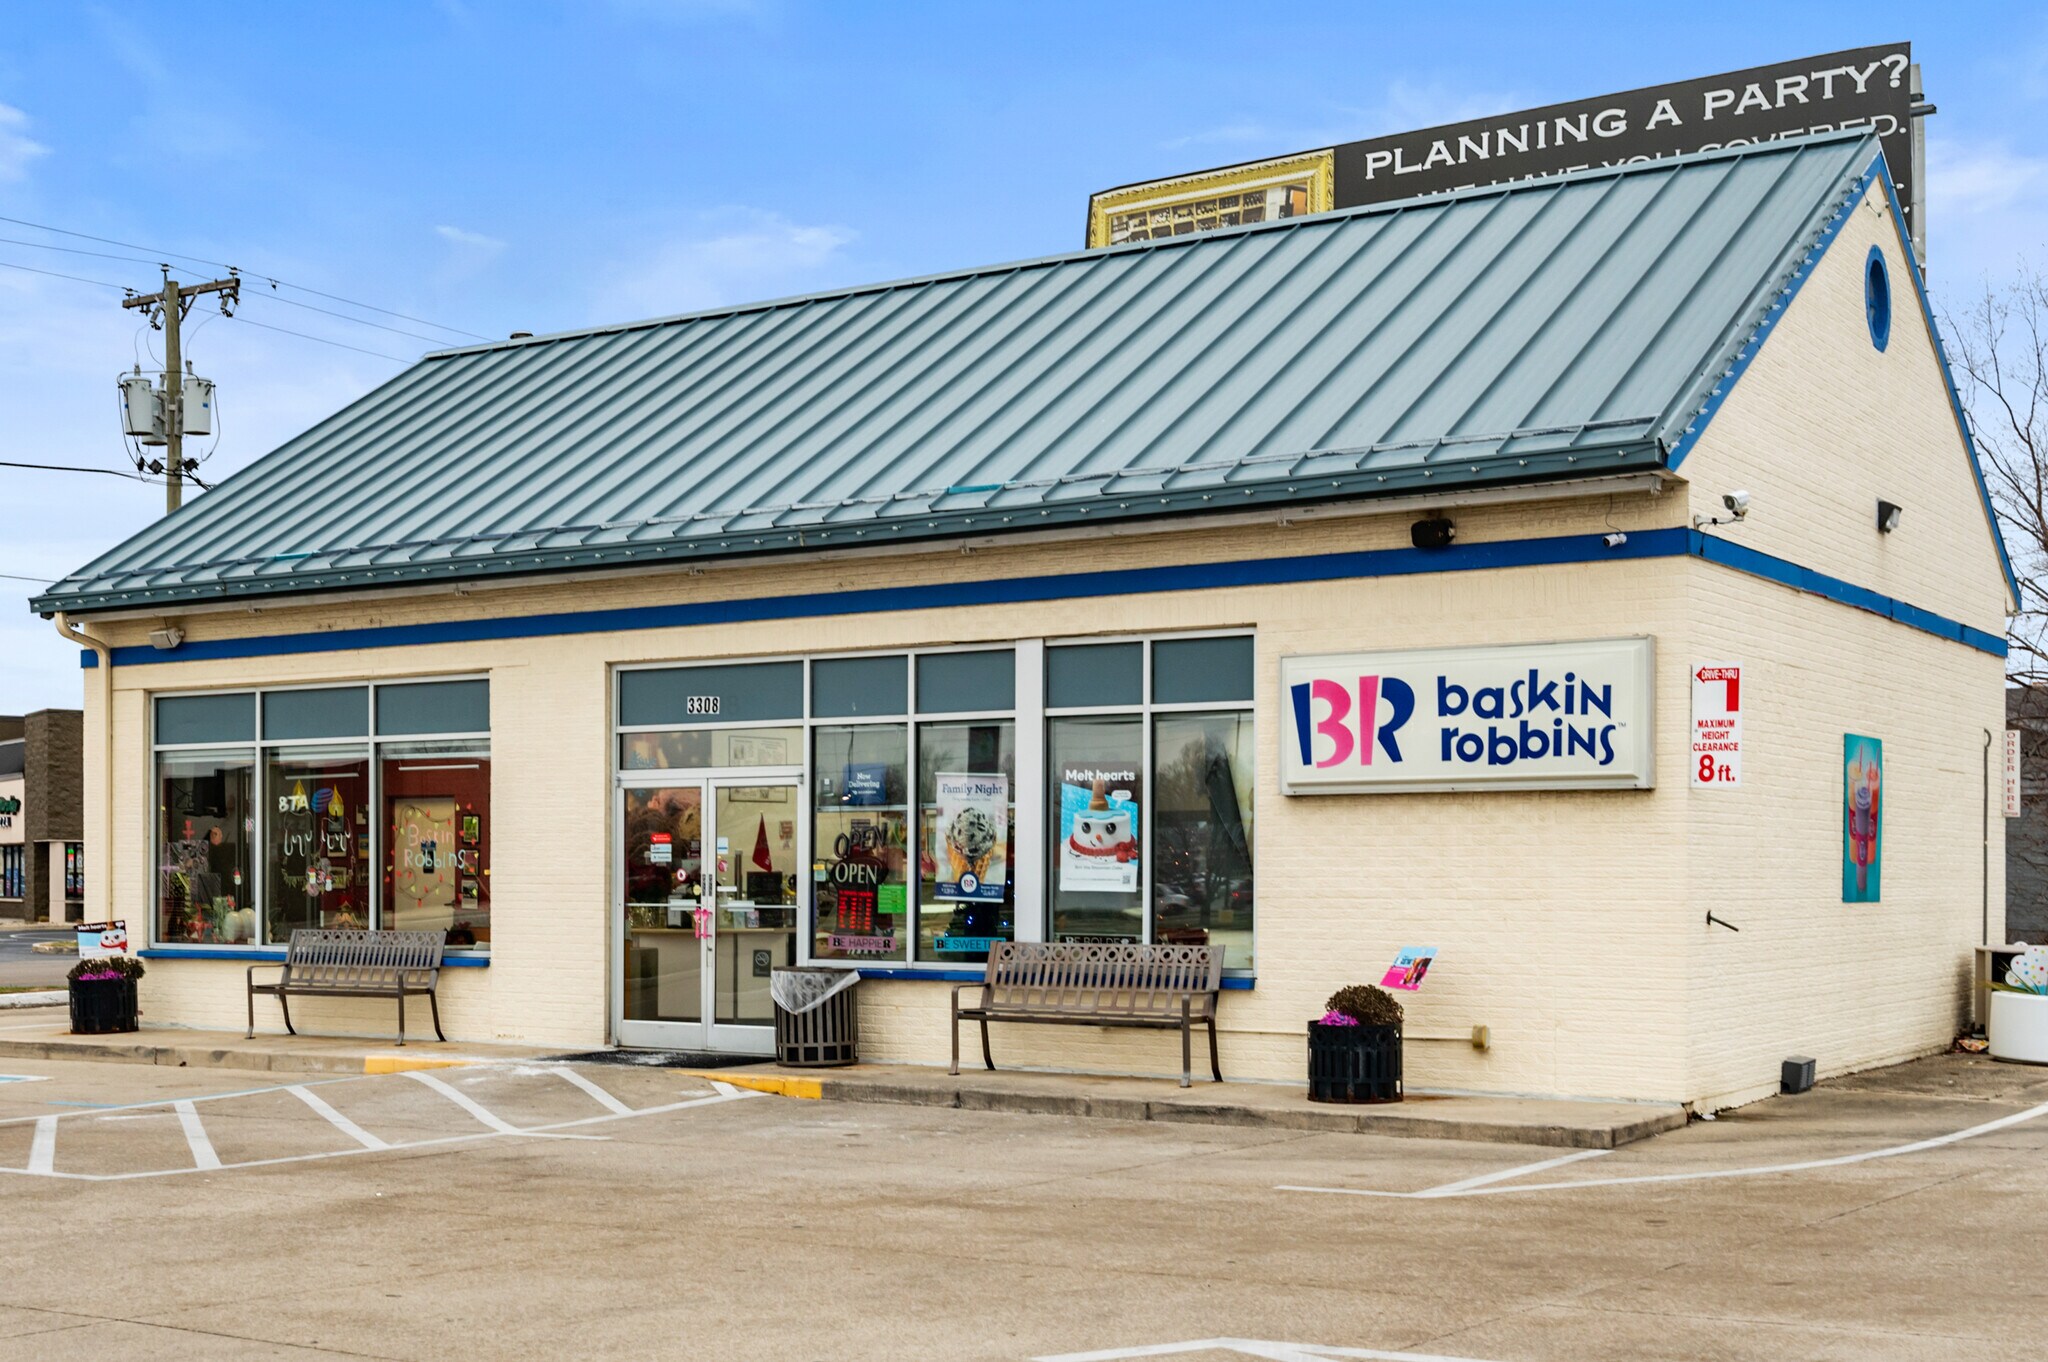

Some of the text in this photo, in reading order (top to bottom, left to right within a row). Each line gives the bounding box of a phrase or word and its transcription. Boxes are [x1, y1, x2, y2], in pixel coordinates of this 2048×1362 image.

[1365, 108, 1627, 180] PLANNING
[1645, 98, 1682, 131] A
[1703, 53, 1909, 121] PARTY?
[1701, 668, 1738, 680] DRIVE-THRU
[1437, 668, 1612, 720] baskin
[688, 697, 719, 714] 3308
[1290, 674, 1415, 769] BR
[1697, 719, 1735, 729] MAXIMUM
[1441, 717, 1617, 767] robbins
[1701, 731, 1730, 740] HEIGHT
[1693, 742, 1739, 752] CLEARANCE
[2006, 732, 2016, 772] ORDER
[1065, 768, 1136, 782] Melt hearts
[1698, 754, 1736, 782] 8 ft.
[942, 783, 1003, 797] Family Night
[2006, 779, 2015, 810] HERE
[834, 822, 888, 859] OPEN
[835, 862, 878, 884] OPEN
[833, 937, 891, 949] BE HAPPIER
[936, 939, 951, 949] BE
